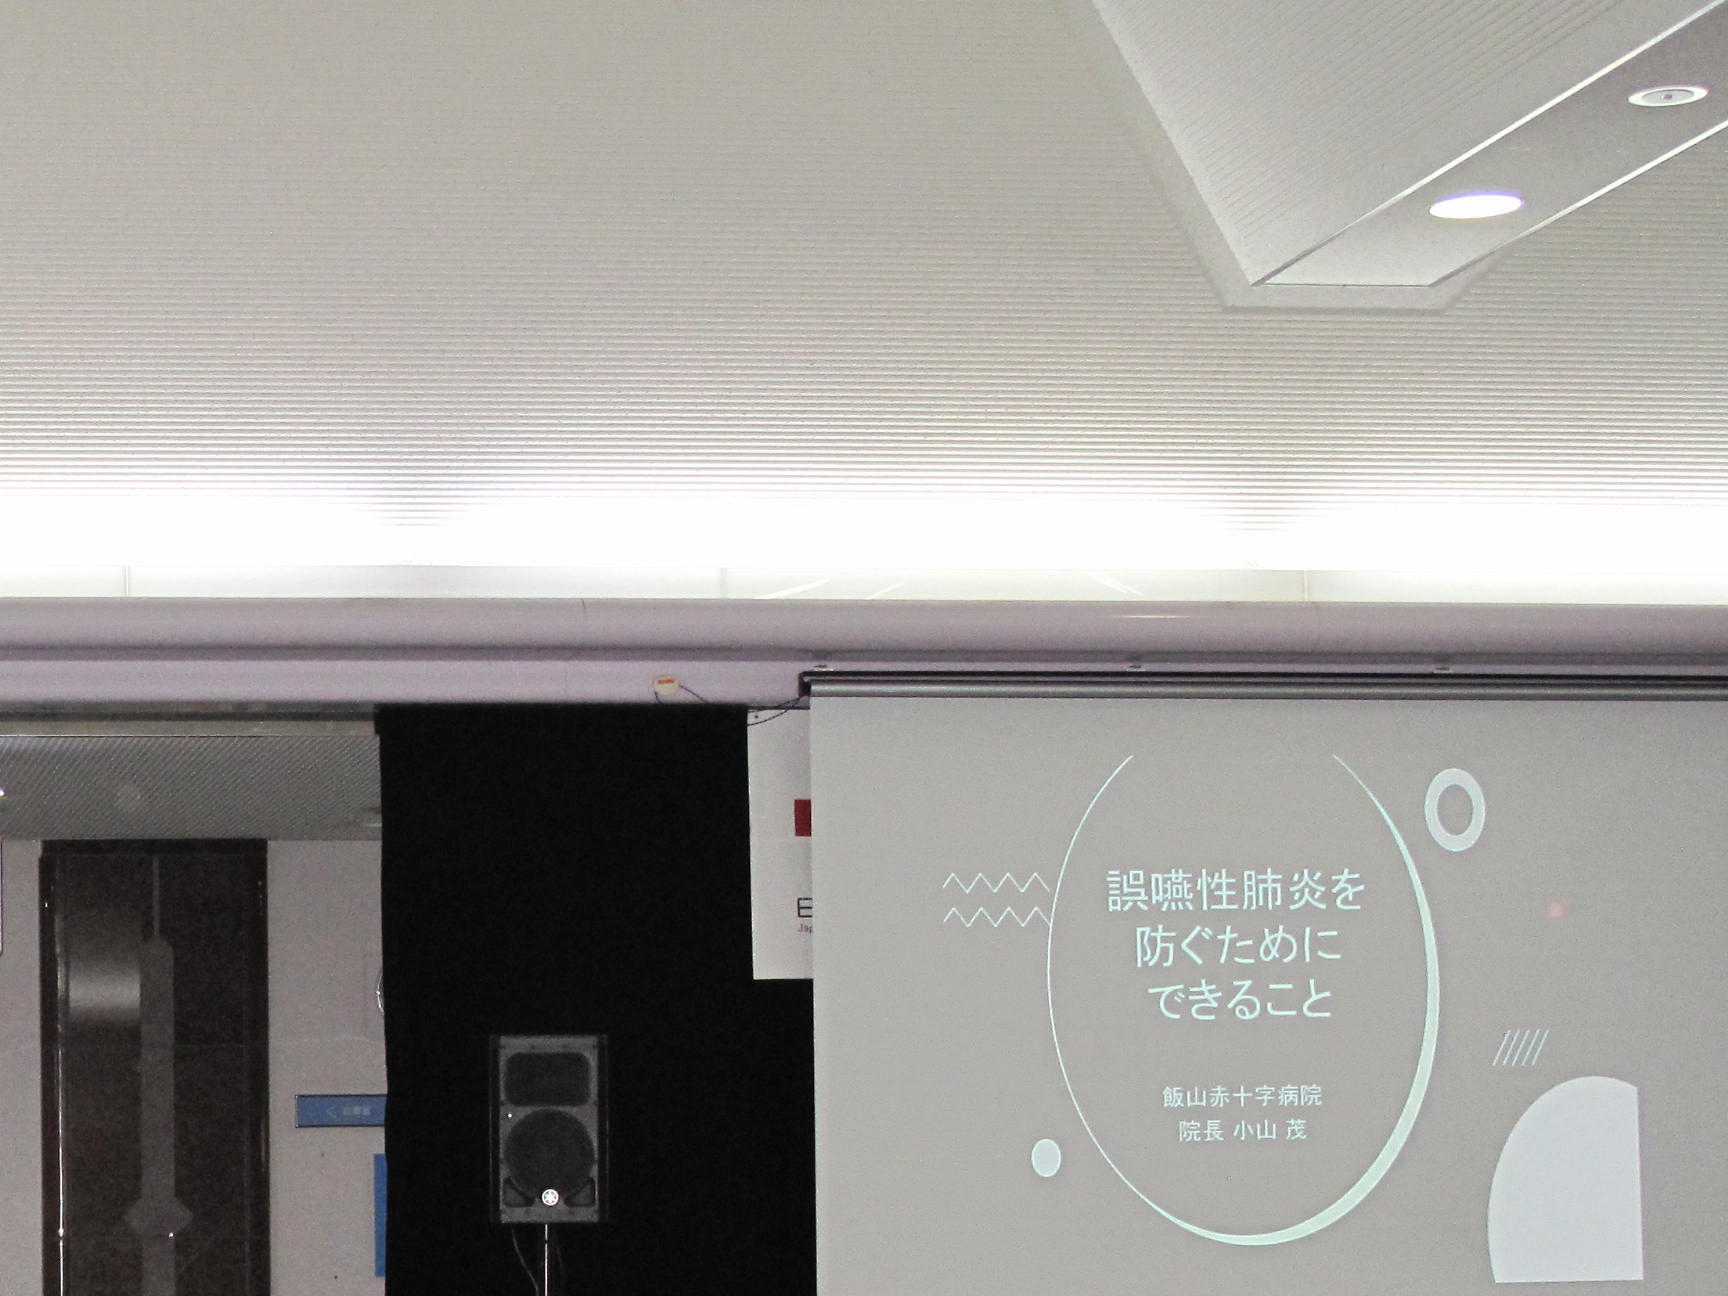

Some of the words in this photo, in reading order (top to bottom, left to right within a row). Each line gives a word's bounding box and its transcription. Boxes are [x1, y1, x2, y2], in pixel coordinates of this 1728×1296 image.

[1106, 867, 1365, 911] 誤嚥性肺炎を
[1135, 924, 1341, 967] 防ぐために
[1148, 979, 1331, 1020] できること
[1162, 1084, 1322, 1107] 飯山赤十字病院
[1178, 1119, 1224, 1142] 院長
[1233, 1119, 1277, 1140] 小山
[1285, 1118, 1307, 1140] 茂
